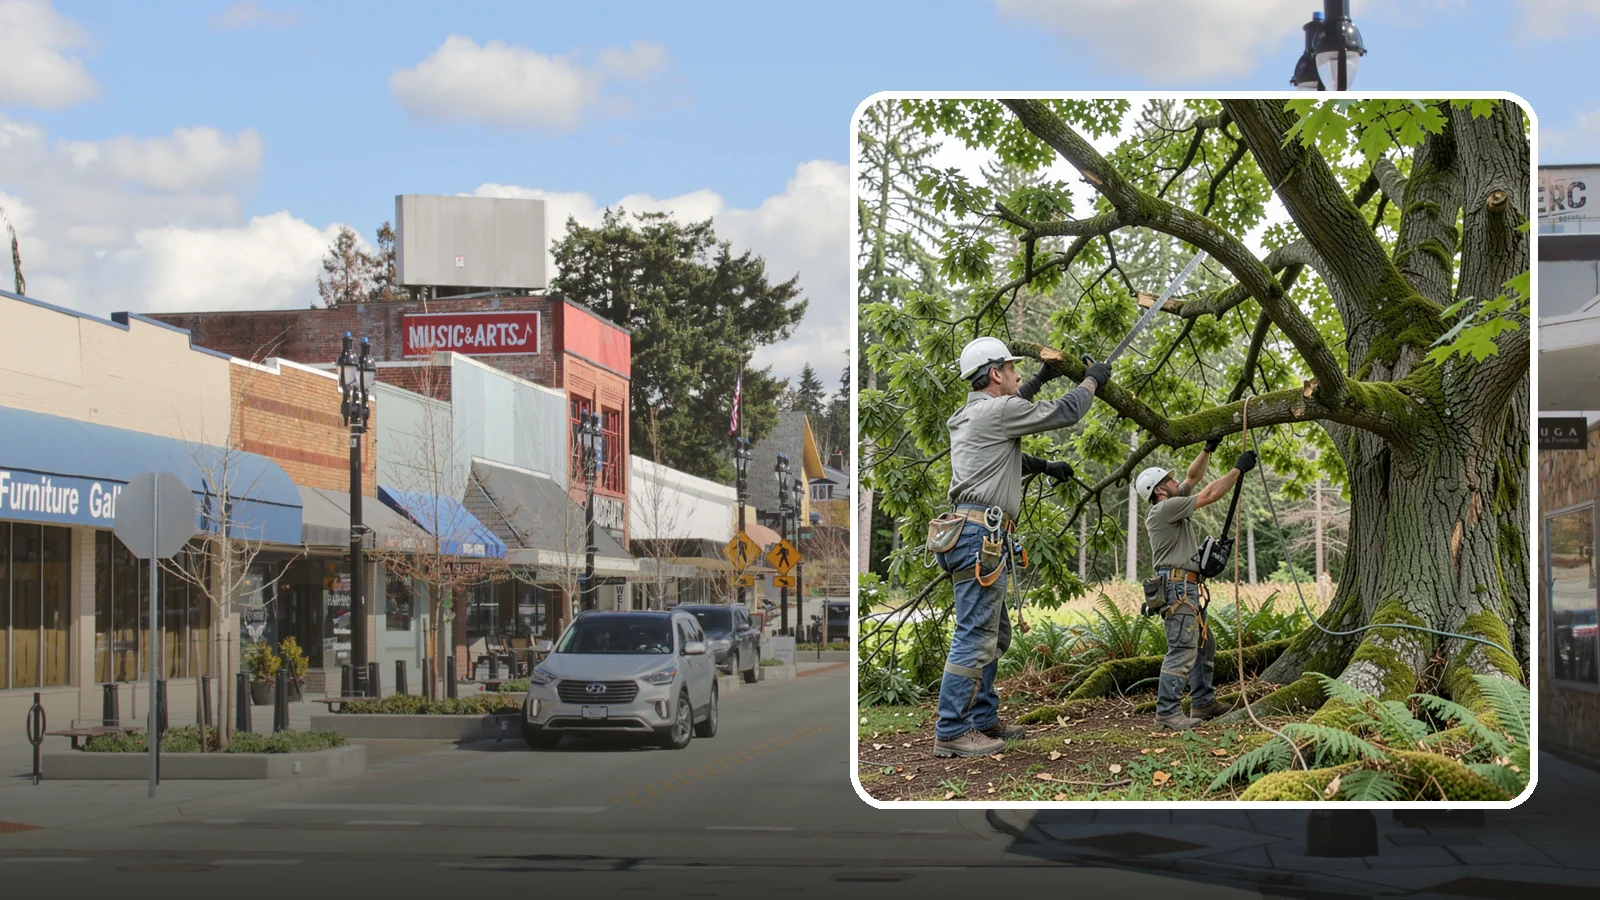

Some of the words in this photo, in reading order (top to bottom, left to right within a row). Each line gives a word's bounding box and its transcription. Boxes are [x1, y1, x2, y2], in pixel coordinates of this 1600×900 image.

[1538, 181, 1587, 212] ERC
[1540, 427, 1577, 437] UGA
[0, 471, 79, 516] Furniture
